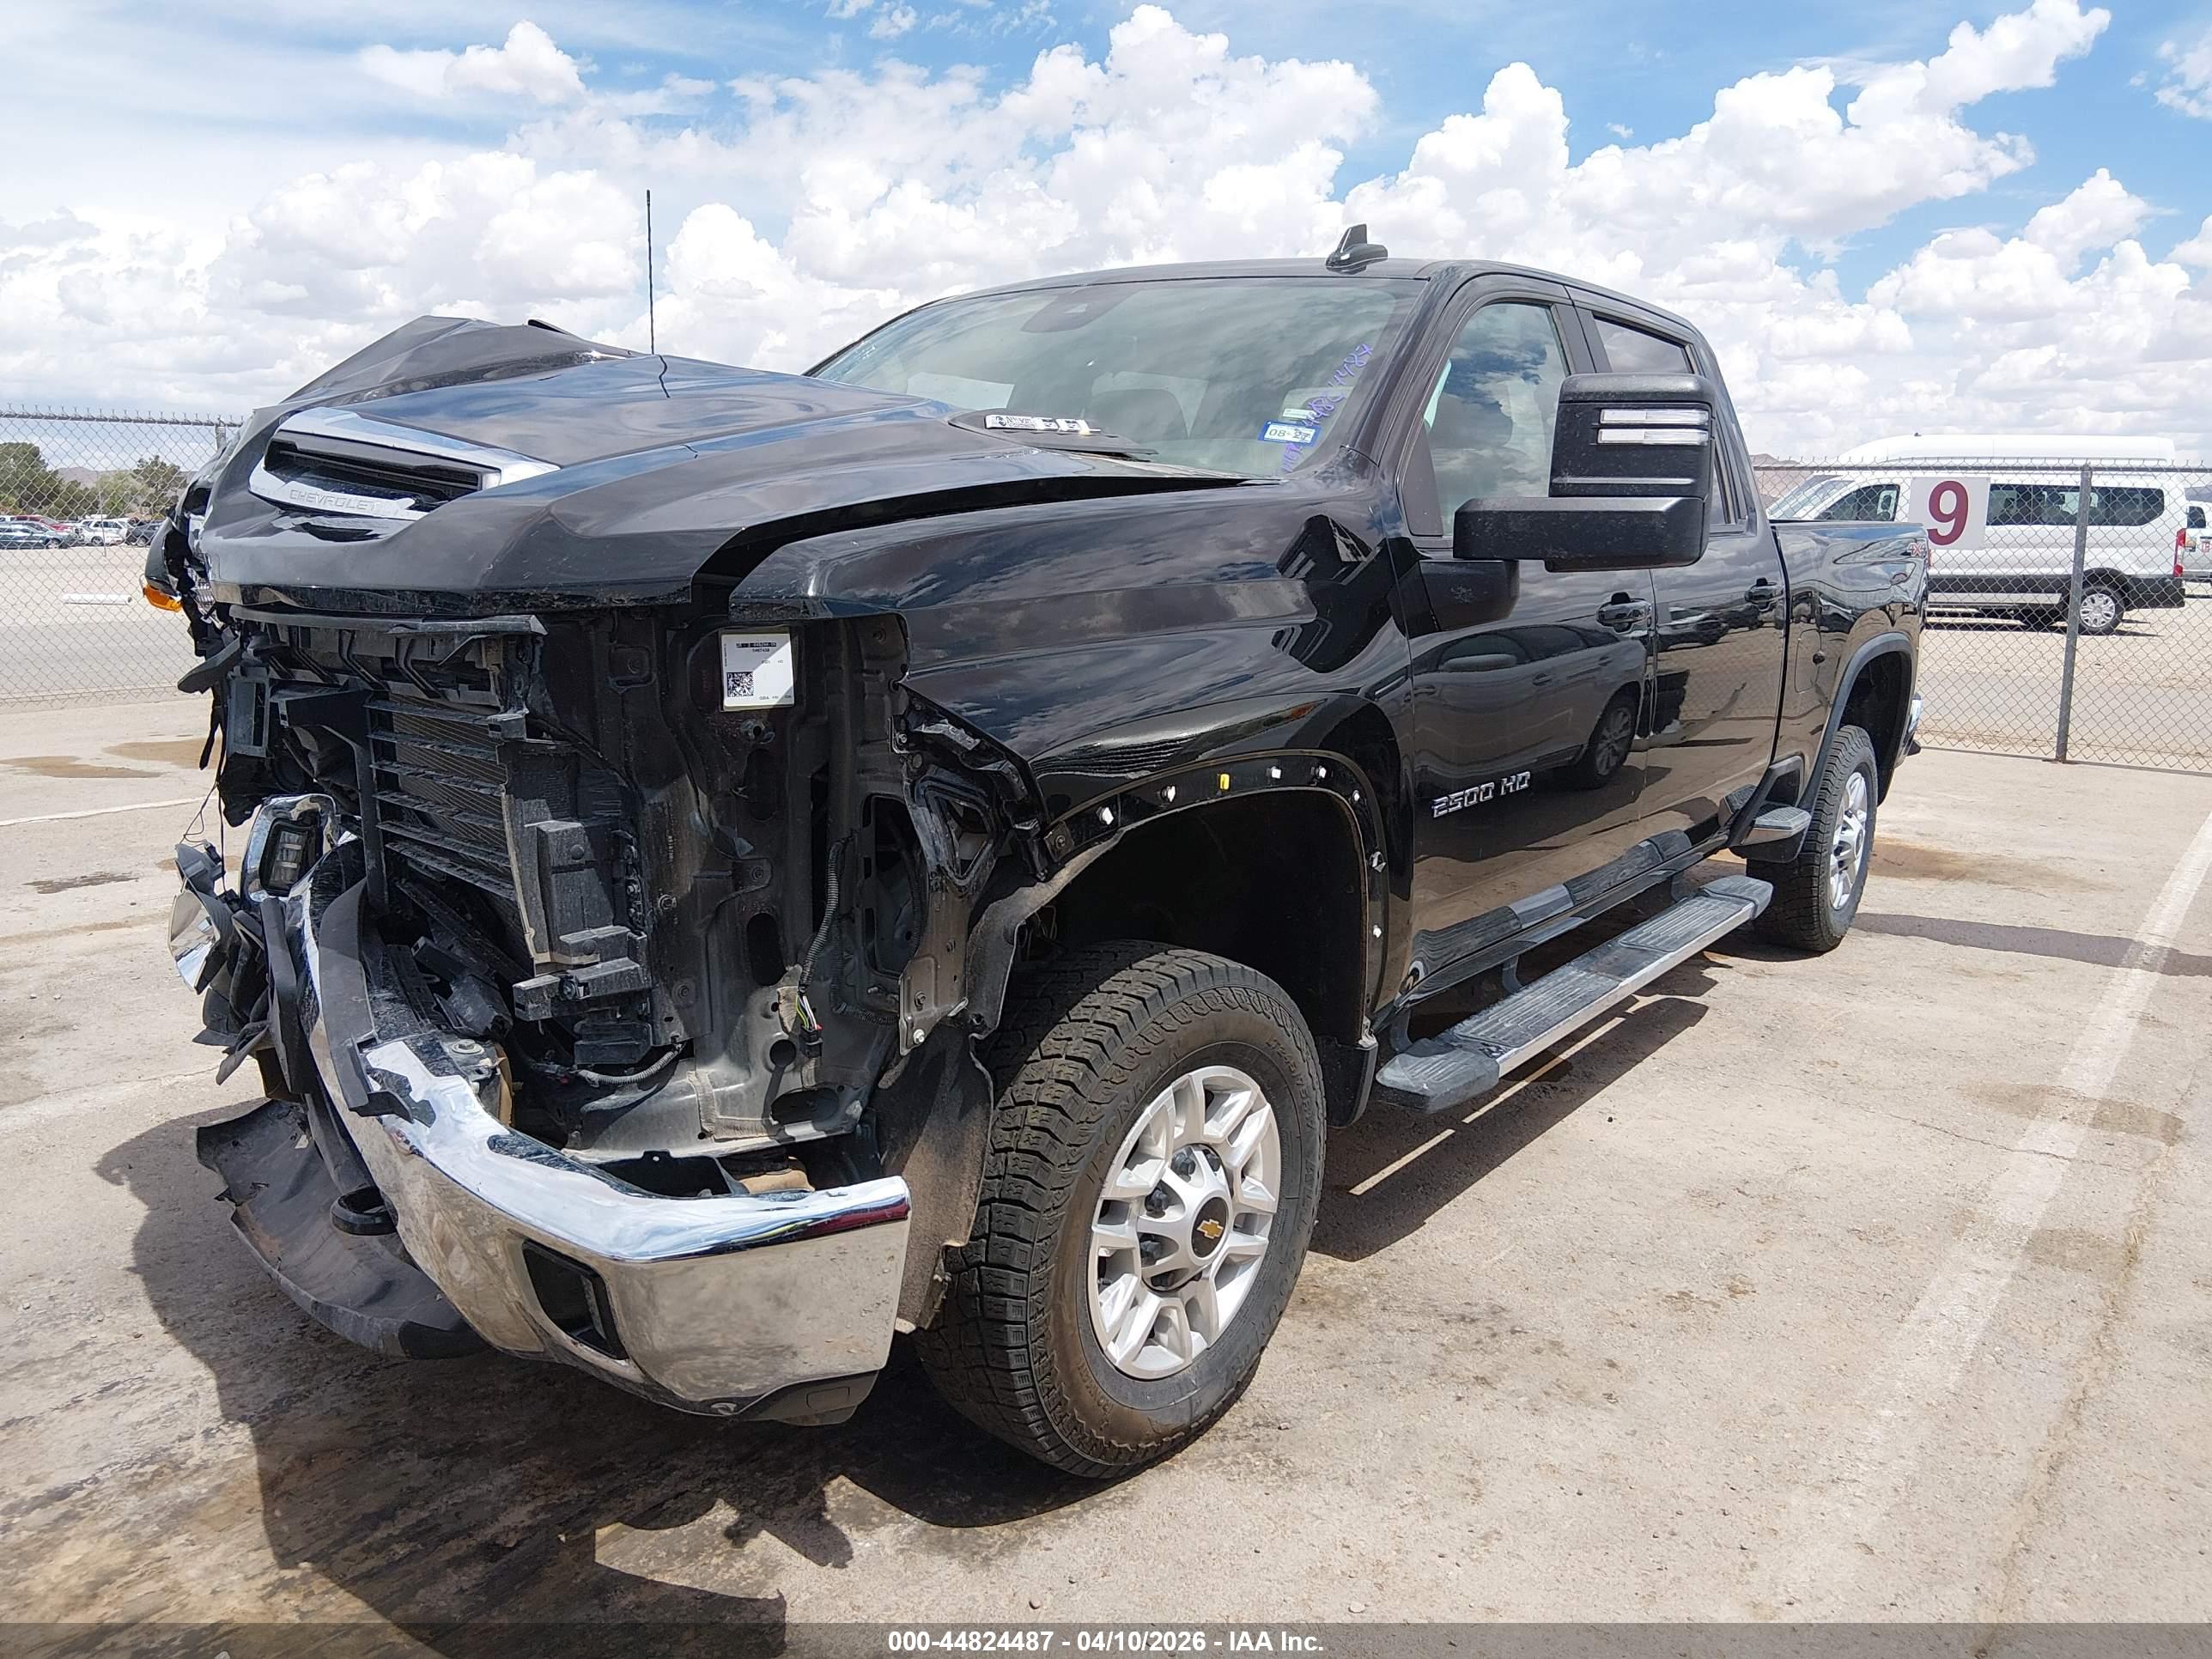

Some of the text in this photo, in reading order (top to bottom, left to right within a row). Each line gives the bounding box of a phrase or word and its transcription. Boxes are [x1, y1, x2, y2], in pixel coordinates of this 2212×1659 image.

[289, 489, 380, 511] CHEVROLET
[1927, 480, 1969, 546] 9
[1431, 771, 1531, 818] 2500 HD
